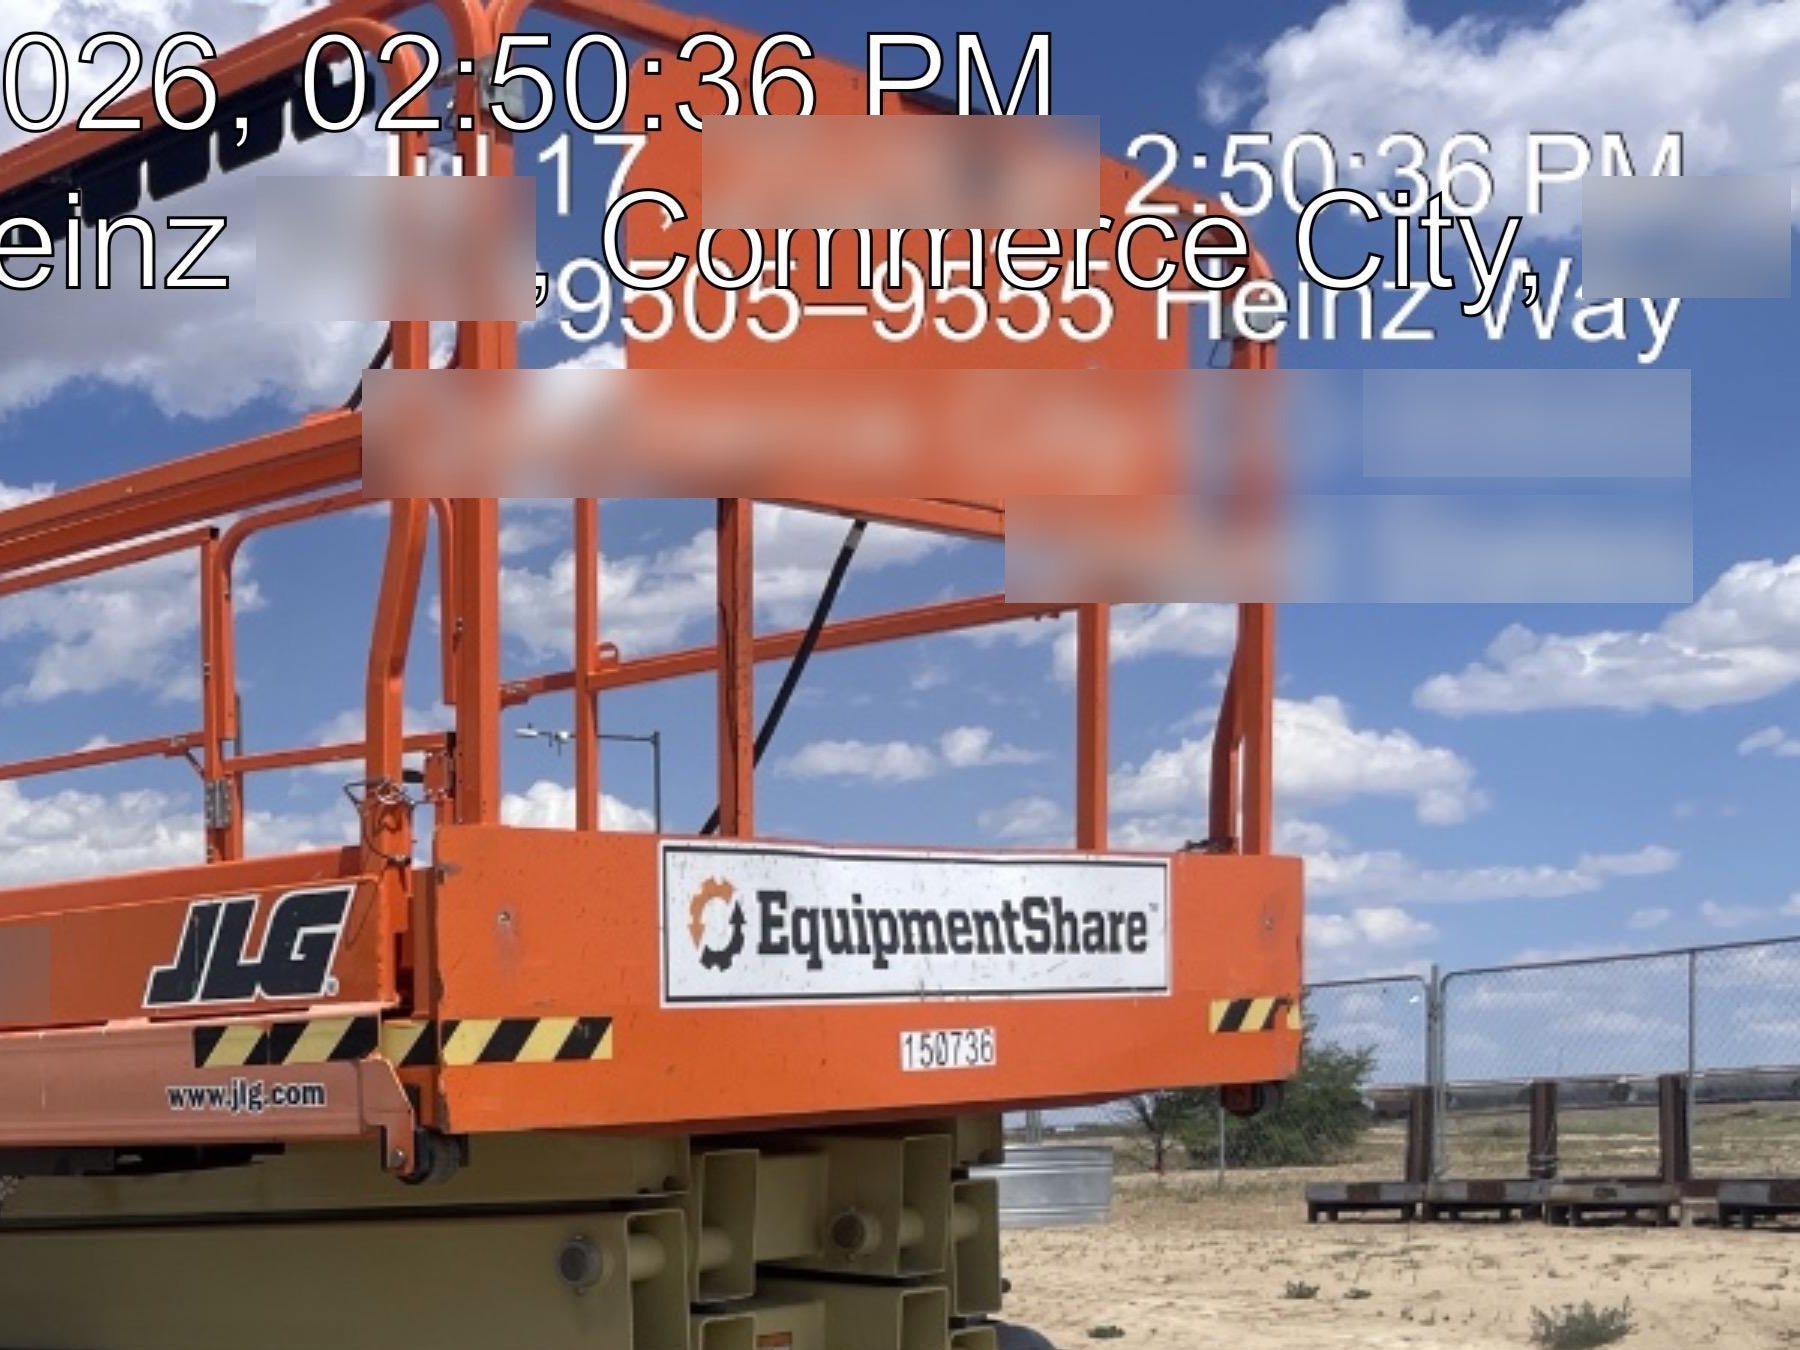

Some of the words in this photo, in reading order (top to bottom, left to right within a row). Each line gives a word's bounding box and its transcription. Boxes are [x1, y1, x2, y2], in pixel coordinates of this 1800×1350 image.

[144, 885, 355, 1007] JLG
[756, 890, 1149, 970] EquipmentShare
[905, 1029, 994, 1068] 150736
[167, 1077, 327, 1113] www.jlg.com
